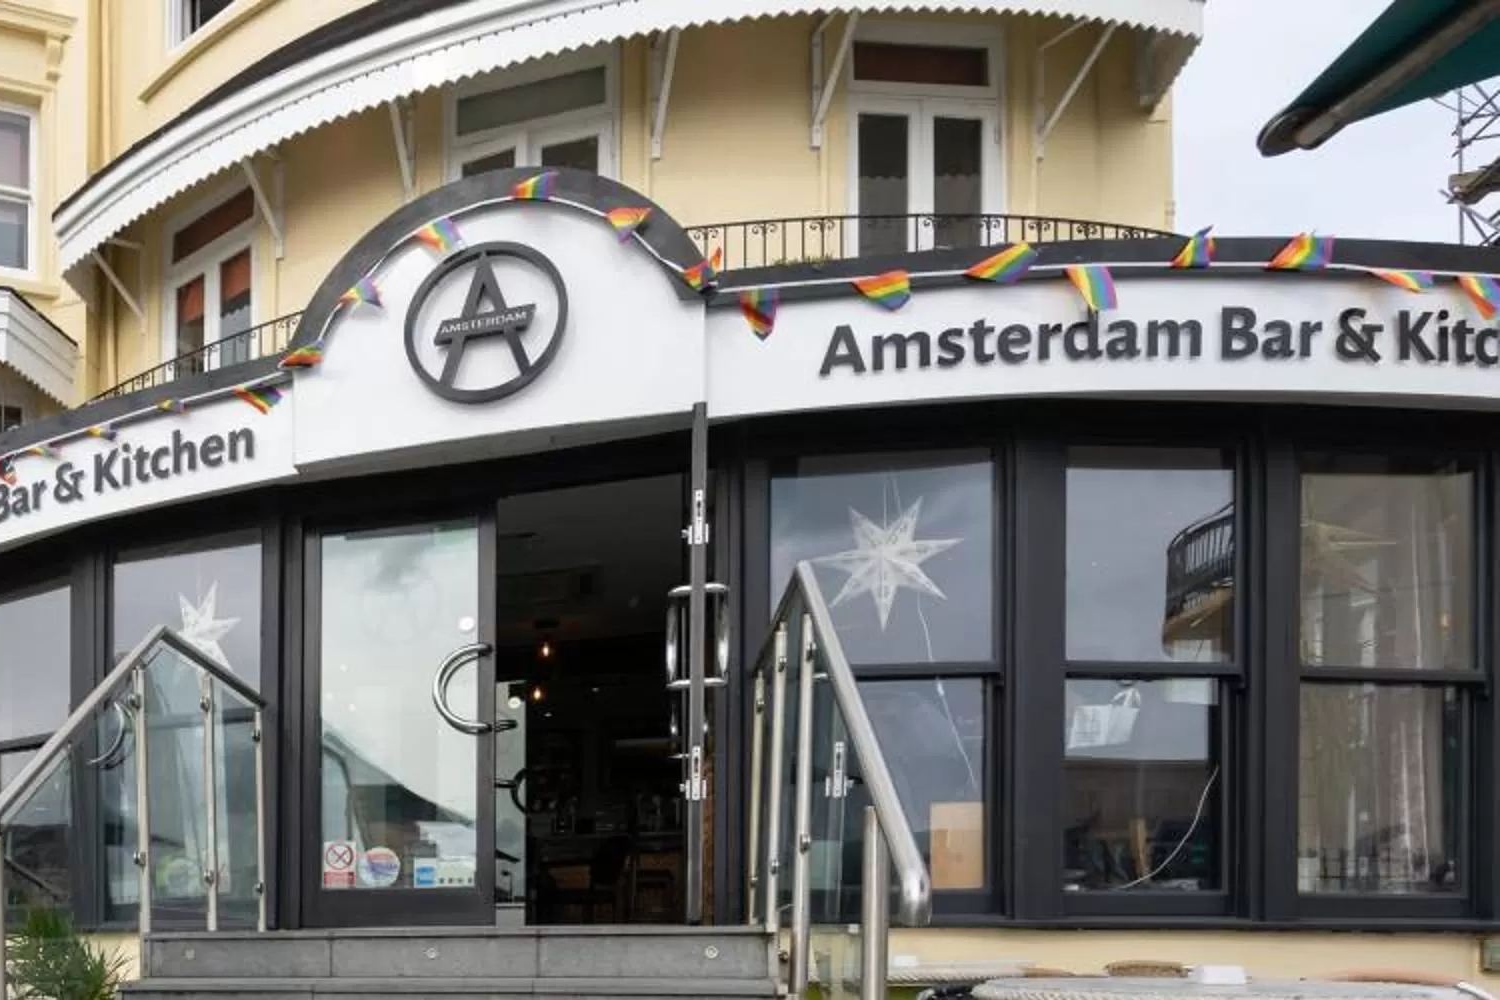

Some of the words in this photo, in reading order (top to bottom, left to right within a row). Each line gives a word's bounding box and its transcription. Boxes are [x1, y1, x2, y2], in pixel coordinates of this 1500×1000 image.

[440, 310, 527, 334] AMSTERDAM
[819, 310, 1202, 377] Amsterdam
[1221, 306, 1323, 360] Bar
[1335, 307, 1384, 363] &
[1398, 309, 1500, 365] Kitc
[53, 460, 85, 504] &
[93, 427, 255, 494] Kitchen
